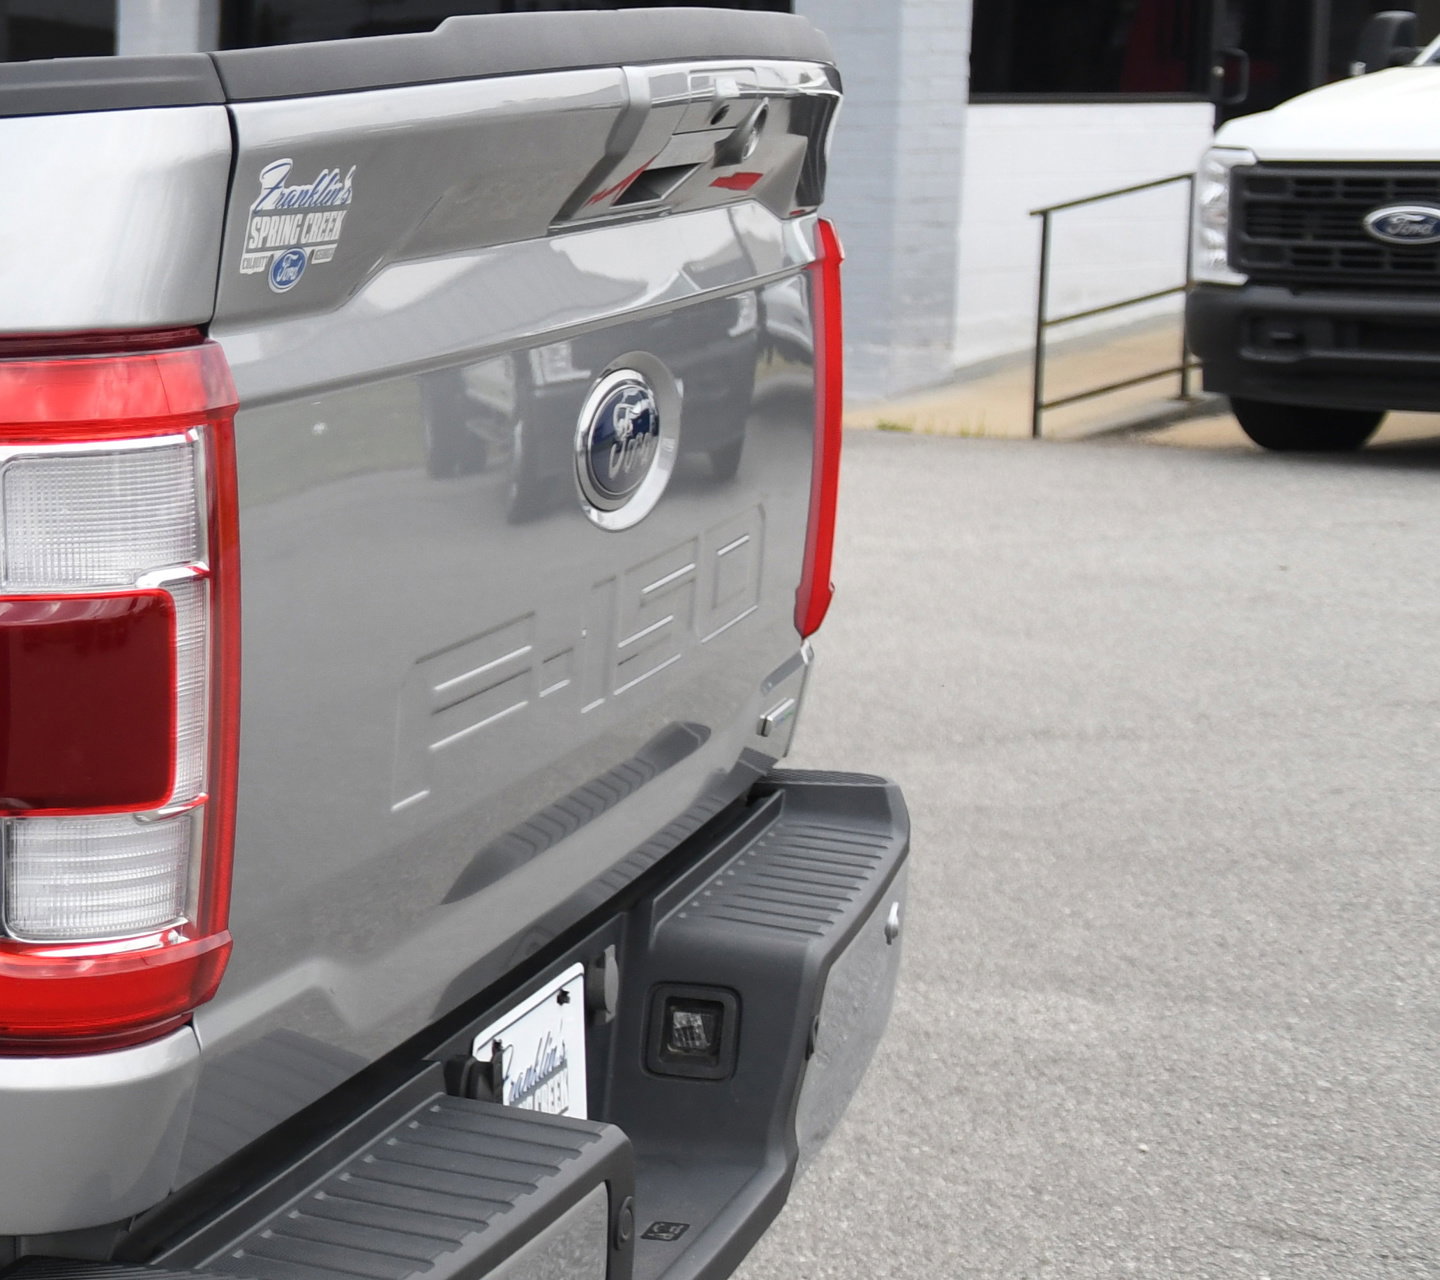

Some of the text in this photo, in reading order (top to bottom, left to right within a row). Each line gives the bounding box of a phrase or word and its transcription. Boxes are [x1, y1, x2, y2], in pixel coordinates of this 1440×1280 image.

[248, 209, 348, 249] SPRING CREEK
[1388, 213, 1437, 235] Ford
[275, 253, 302, 282] Ford
[608, 398, 657, 480] Ford
[391, 501, 767, 812] F-150
